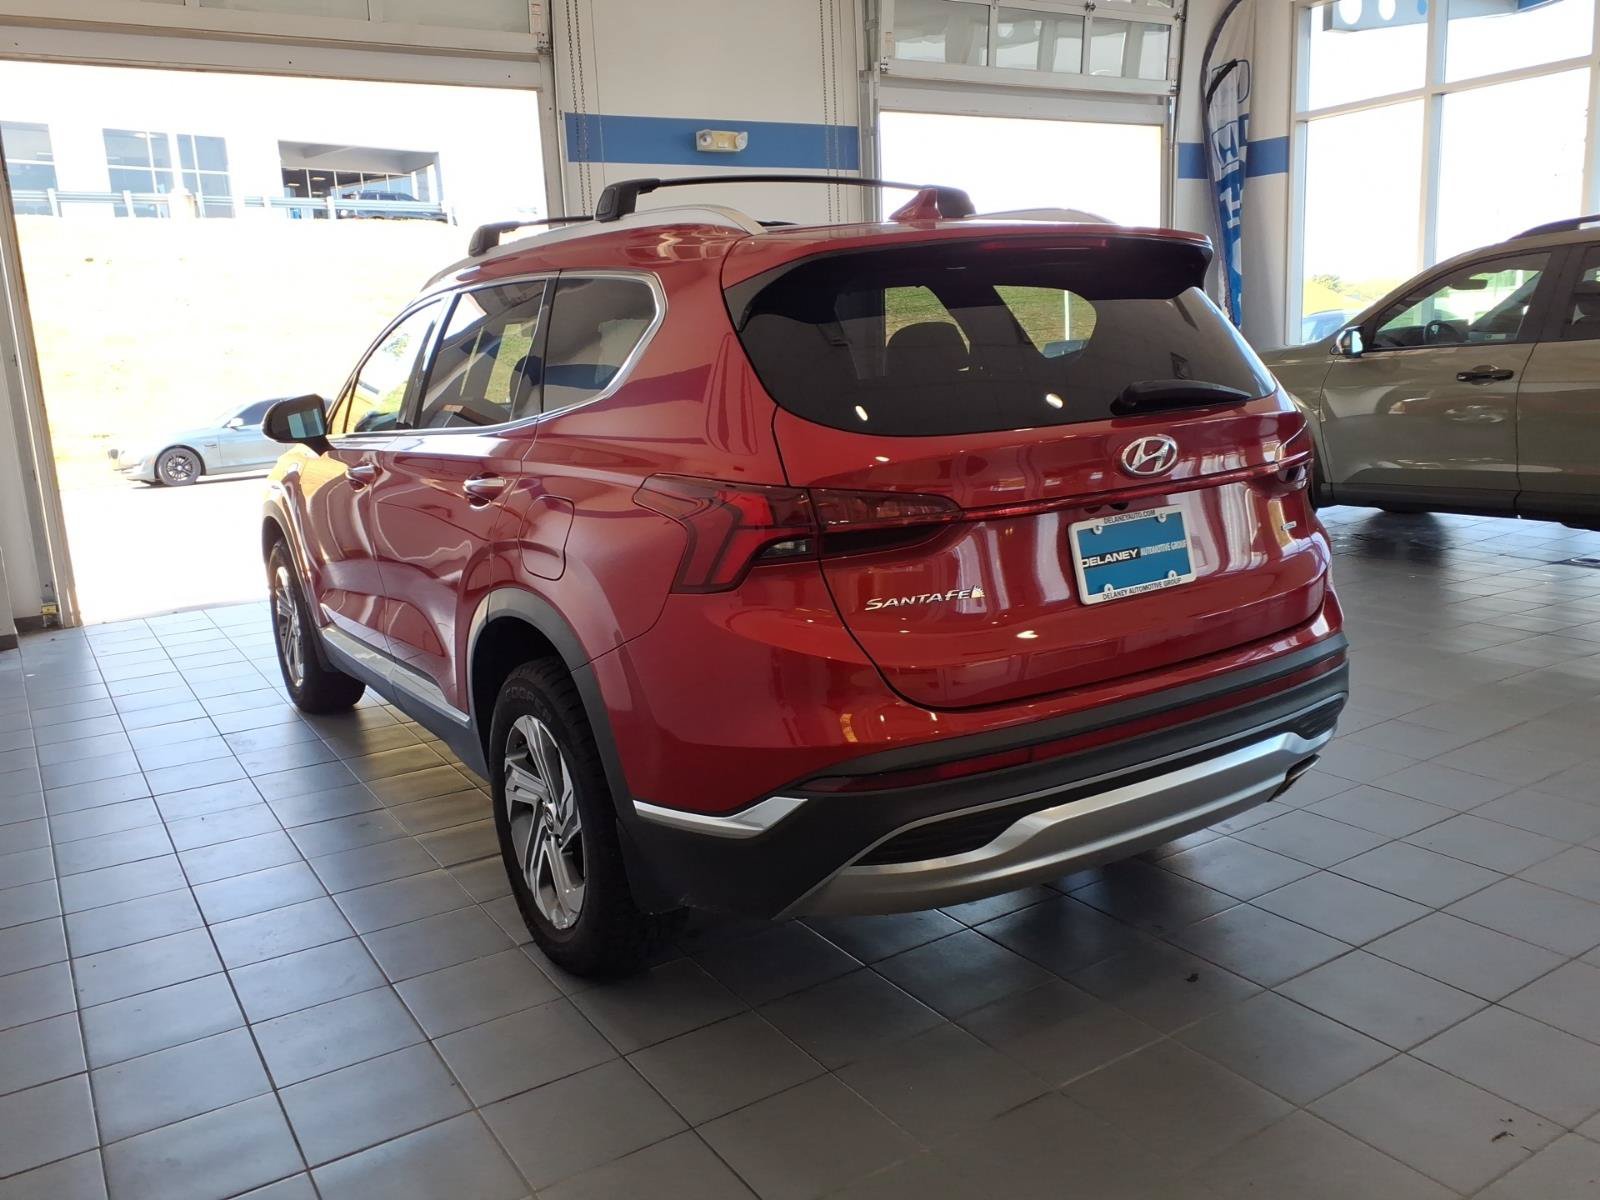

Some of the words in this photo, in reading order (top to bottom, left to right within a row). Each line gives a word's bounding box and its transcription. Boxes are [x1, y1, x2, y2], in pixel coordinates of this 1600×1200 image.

[1103, 510, 1156, 524] DELANEYAUTO.COM
[1081, 548, 1138, 568] DELANEY
[1140, 542, 1170, 556] AUTOMOTIVE
[1102, 590, 1128, 600] DELANEY
[1128, 582, 1162, 594] AUTOMOTIVE
[1163, 578, 1181, 588] GROUP
